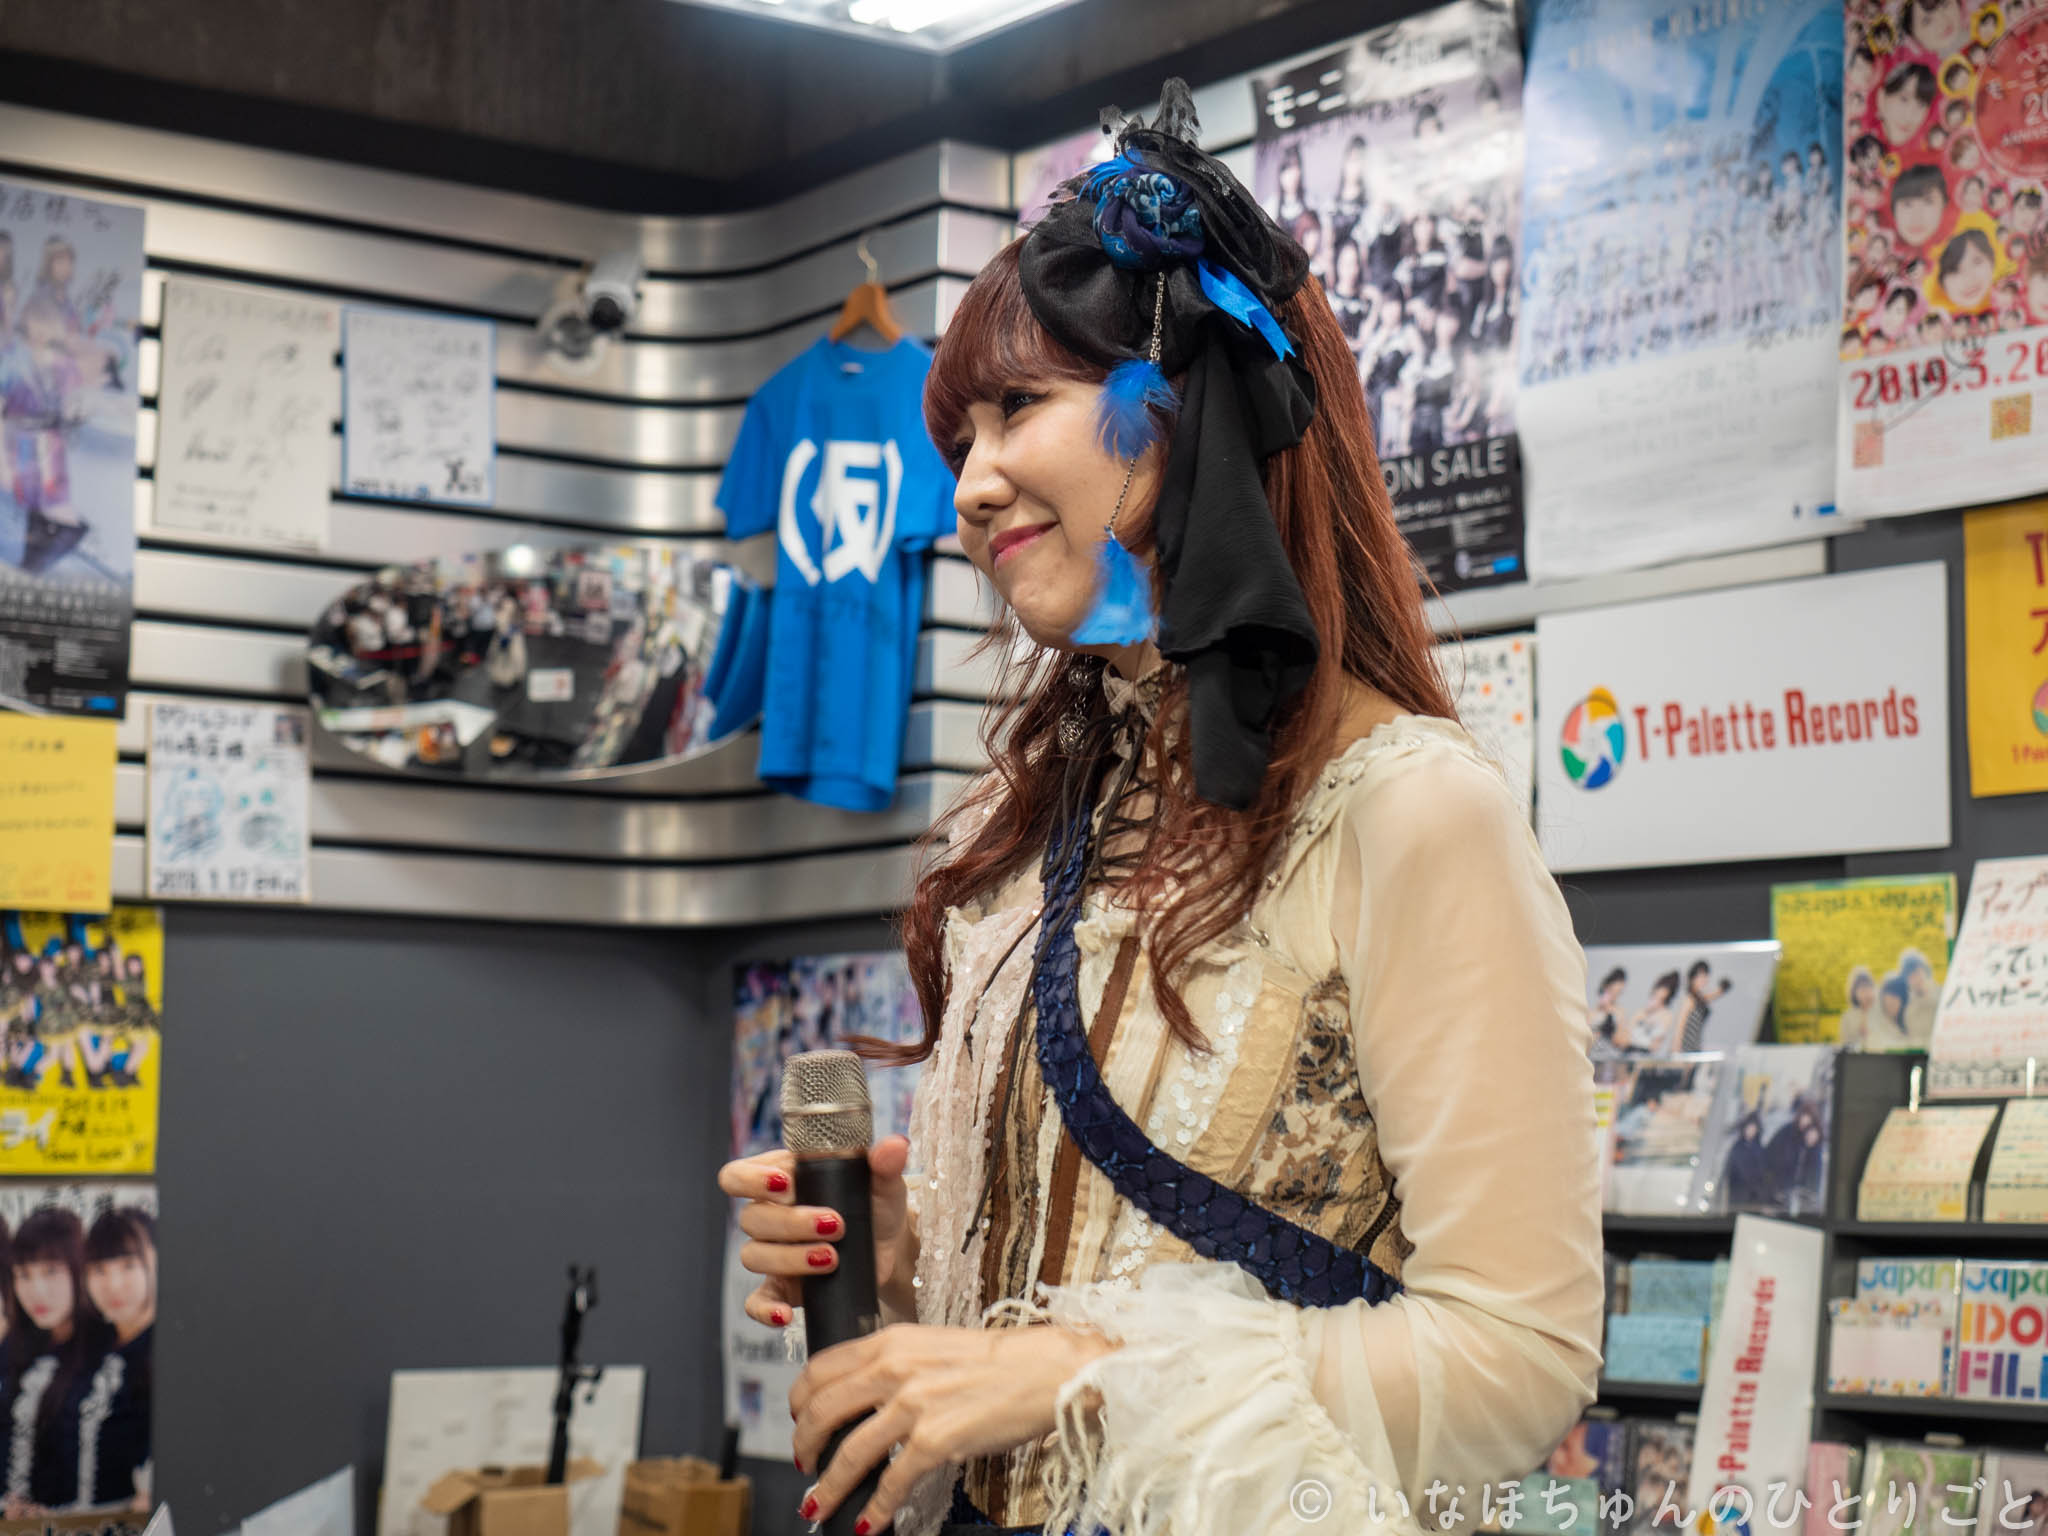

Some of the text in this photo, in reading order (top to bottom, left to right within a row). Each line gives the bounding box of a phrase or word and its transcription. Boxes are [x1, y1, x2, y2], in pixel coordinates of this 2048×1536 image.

[1381, 437, 1508, 497] ON SALE
[1632, 686, 1920, 760] T-Palette Records
[1734, 1276, 1776, 1374] Records
[1961, 1302, 2048, 1346] IDO
